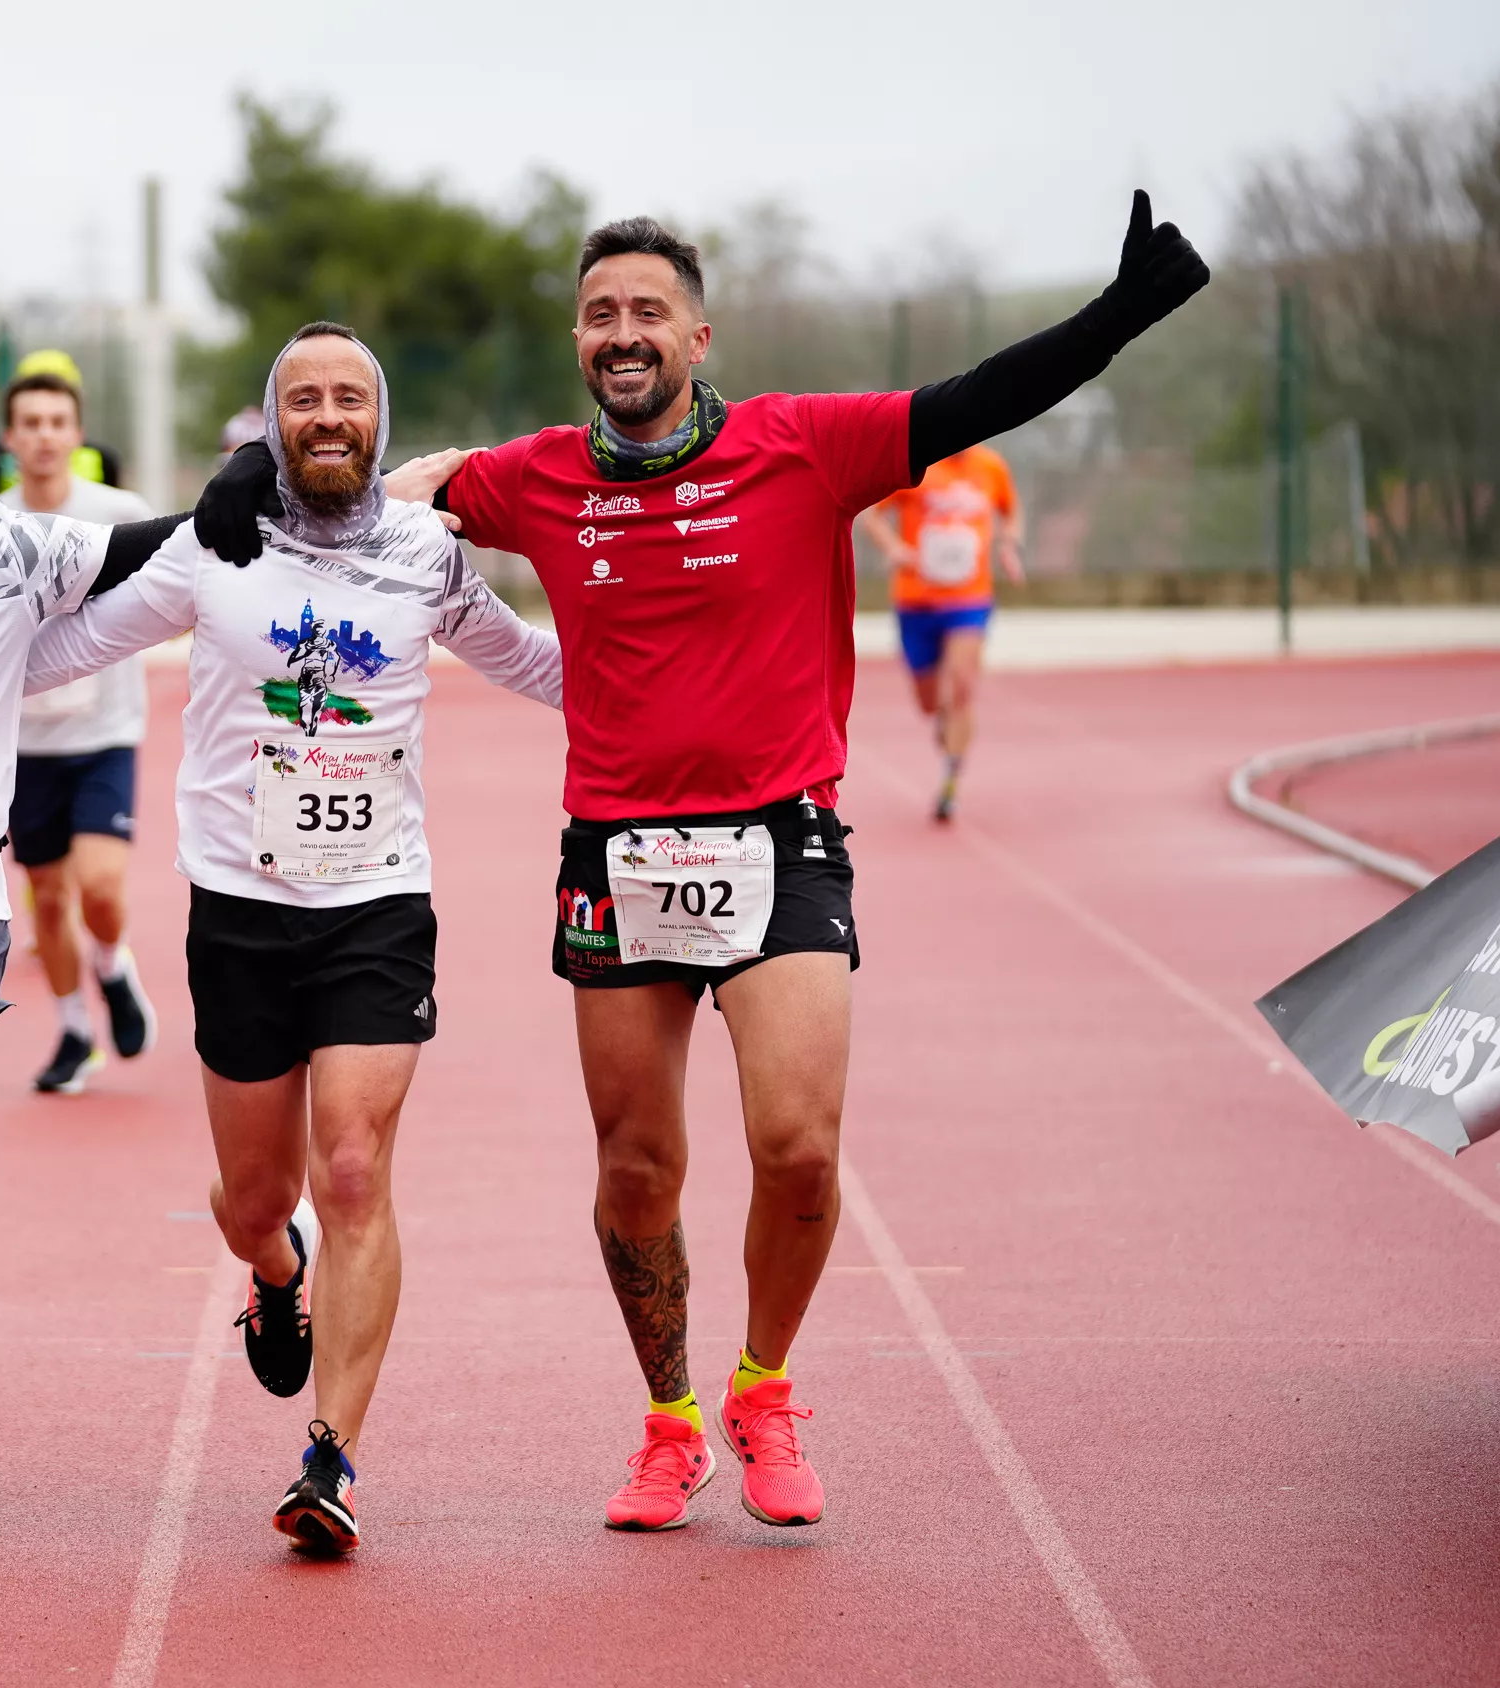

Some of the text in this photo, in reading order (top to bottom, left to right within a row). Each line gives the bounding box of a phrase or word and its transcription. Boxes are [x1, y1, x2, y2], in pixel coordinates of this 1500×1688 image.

[594, 495, 641, 512] califas
[690, 515, 739, 528] AGRIMENSUR
[682, 553, 739, 570] hymcor
[607, 576, 624, 584] CALOR
[321, 763, 368, 780] LUCENA
[296, 793, 373, 832] 353
[318, 842, 339, 850] GARCÍA
[671, 852, 723, 866] LUCENA
[651, 880, 735, 918] 702
[564, 926, 606, 947] HABITANTES
[584, 950, 623, 967] Tapas
